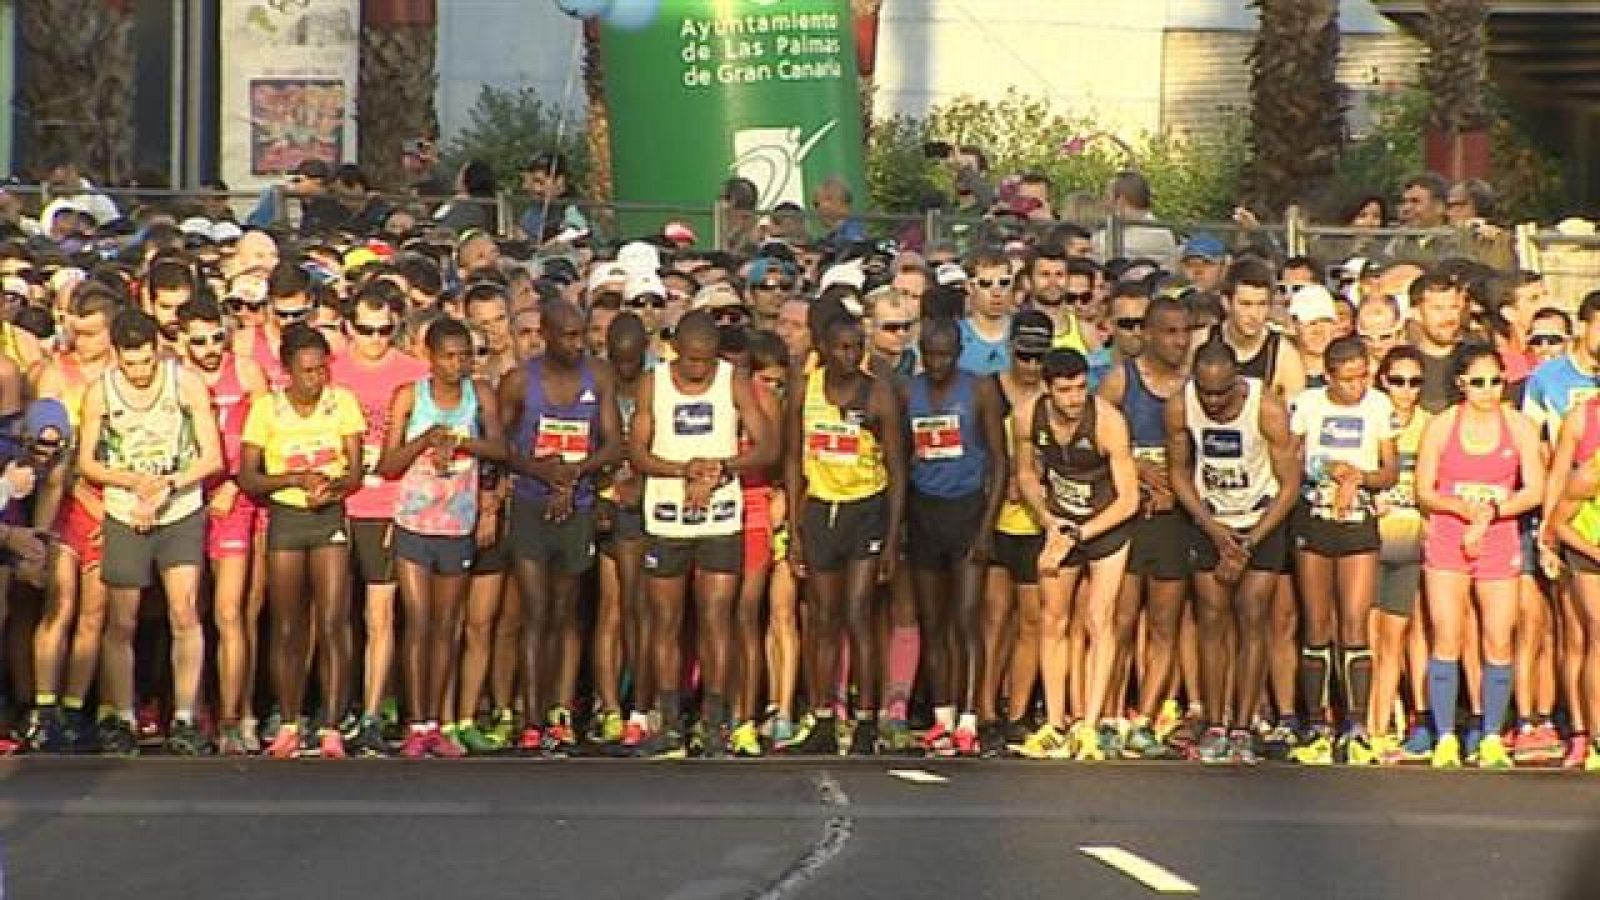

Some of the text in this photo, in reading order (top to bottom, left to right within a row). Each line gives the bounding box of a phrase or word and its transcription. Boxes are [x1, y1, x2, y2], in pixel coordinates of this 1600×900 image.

[680, 12, 838, 40] Ayuntamiento
[682, 35, 840, 62] de Las Palmas
[684, 65, 711, 85] de
[717, 64, 771, 83] Gran
